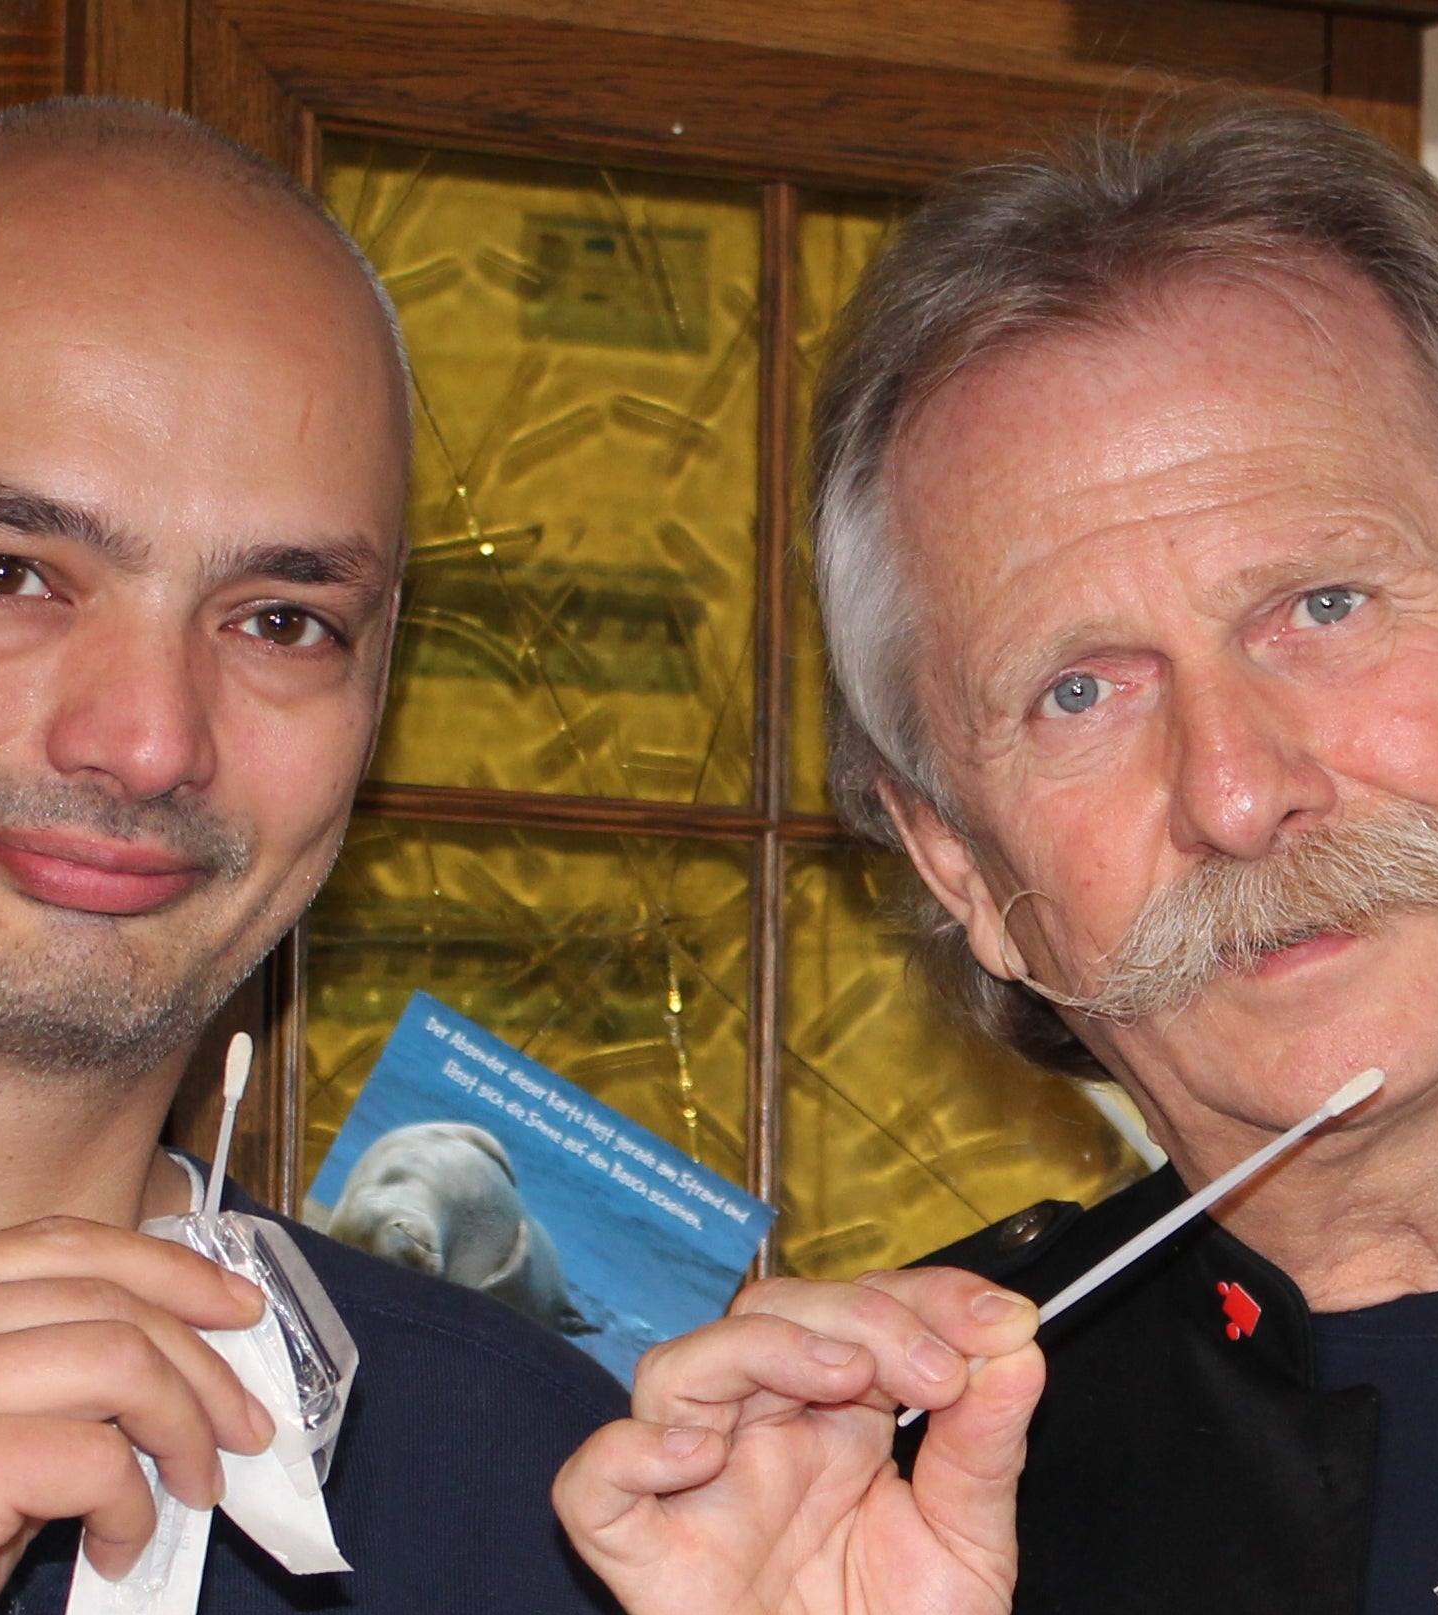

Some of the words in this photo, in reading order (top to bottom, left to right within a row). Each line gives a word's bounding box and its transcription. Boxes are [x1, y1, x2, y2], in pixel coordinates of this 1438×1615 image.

[426, 1017, 450, 1038] Der
[449, 1032, 508, 1075] Absender
[509, 1071, 547, 1099] dieser
[547, 1090, 584, 1123] Karte
[583, 1114, 615, 1144] liegt
[613, 1136, 657, 1168] gerade
[657, 1163, 677, 1182] am
[677, 1172, 726, 1209] Strand
[724, 1204, 749, 1224] und
[443, 1060, 479, 1092] lässt
[478, 1084, 504, 1108] sich
[506, 1102, 525, 1120] die
[525, 1112, 563, 1143] Sonne
[563, 1138, 588, 1156] auf
[587, 1152, 609, 1170] den
[611, 1162, 648, 1196] Bauch
[648, 1190, 702, 1230] scheinen.
